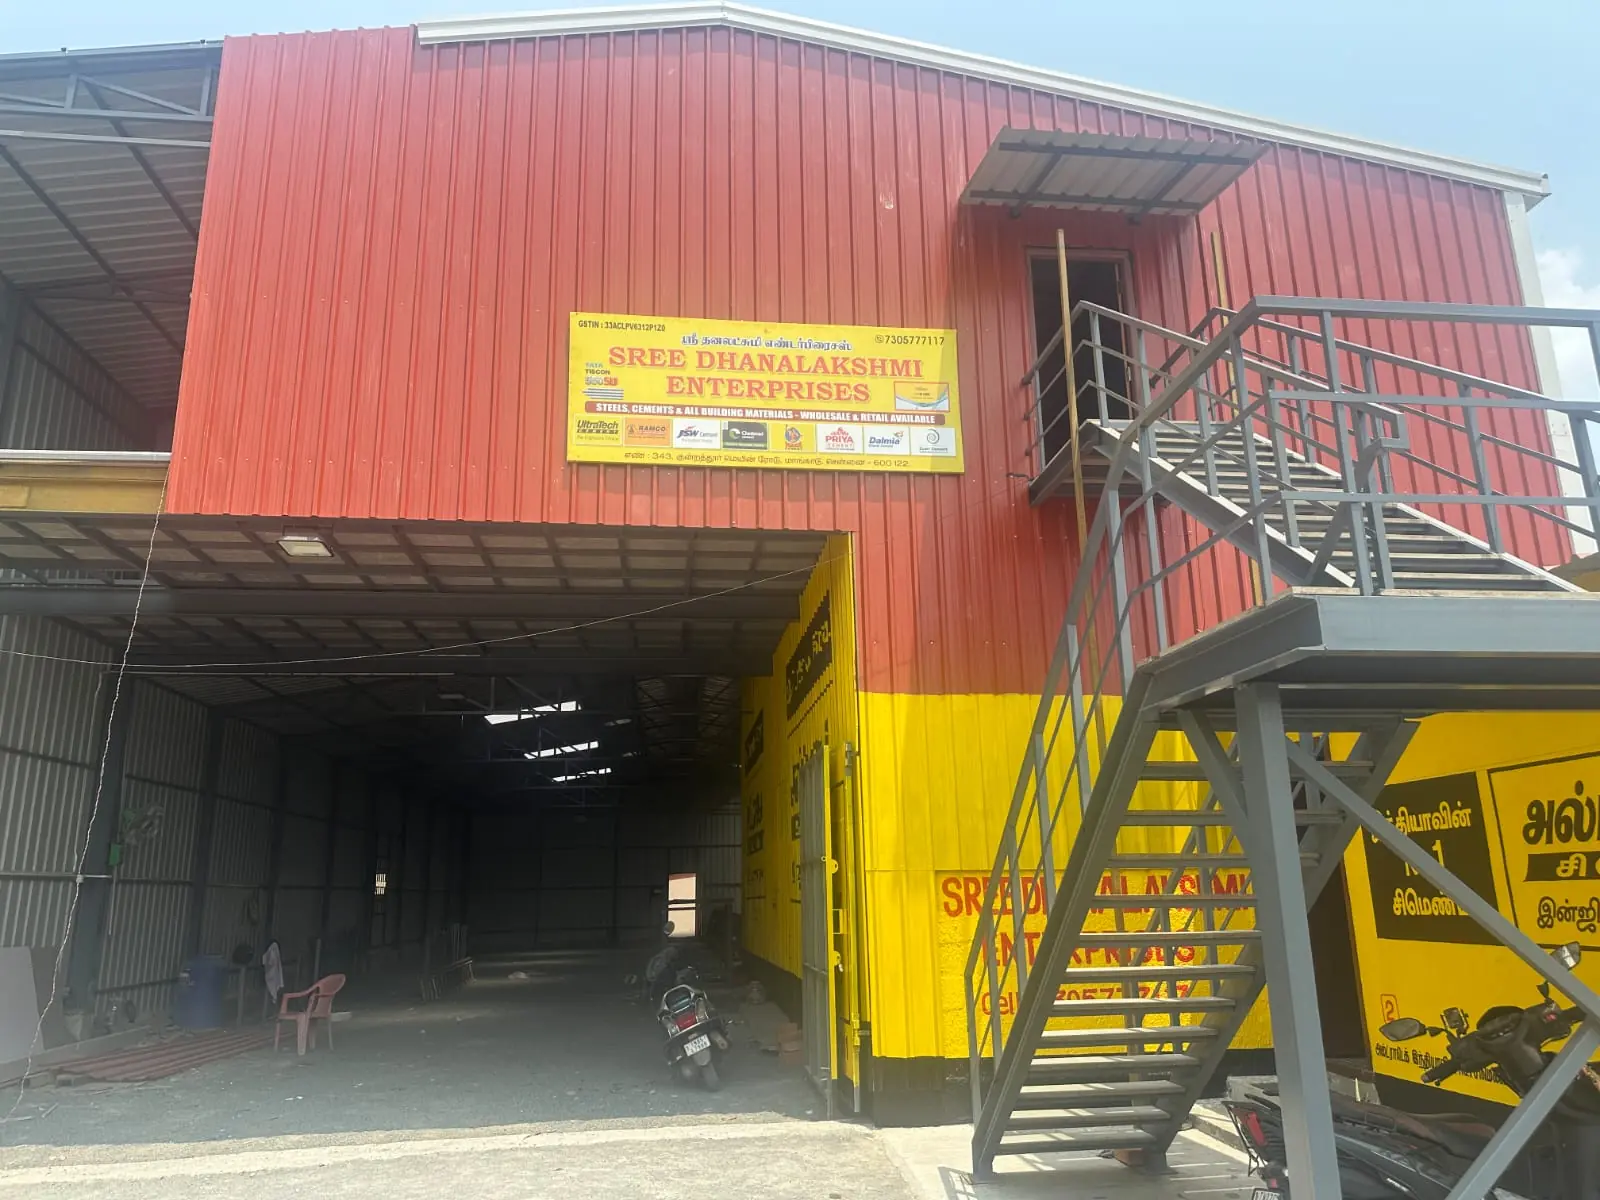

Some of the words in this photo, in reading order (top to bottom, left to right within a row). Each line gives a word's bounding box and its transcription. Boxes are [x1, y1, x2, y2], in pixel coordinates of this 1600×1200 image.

[578, 320, 599, 329] GSTIN
[885, 334, 945, 346] 7305777117
[609, 346, 687, 369] SREE
[696, 350, 923, 378] DHANALAKSHMI
[666, 375, 870, 402] ENTERPRISES
[632, 404, 674, 415] CEMENTS
[675, 407, 682, 415] &
[684, 407, 700, 415] ALL
[701, 408, 743, 417] BUILDING
[745, 408, 793, 419] MATERIALS
[800, 411, 850, 421] WHOLESALE
[853, 414, 859, 422] &
[861, 413, 890, 422] RETAIL
[890, 414, 936, 424] AVAILABLE
[577, 420, 618, 429] UltraTech
[677, 429, 700, 438] JSW
[825, 435, 854, 443] PRIYA
[869, 436, 900, 445] Dalmia
